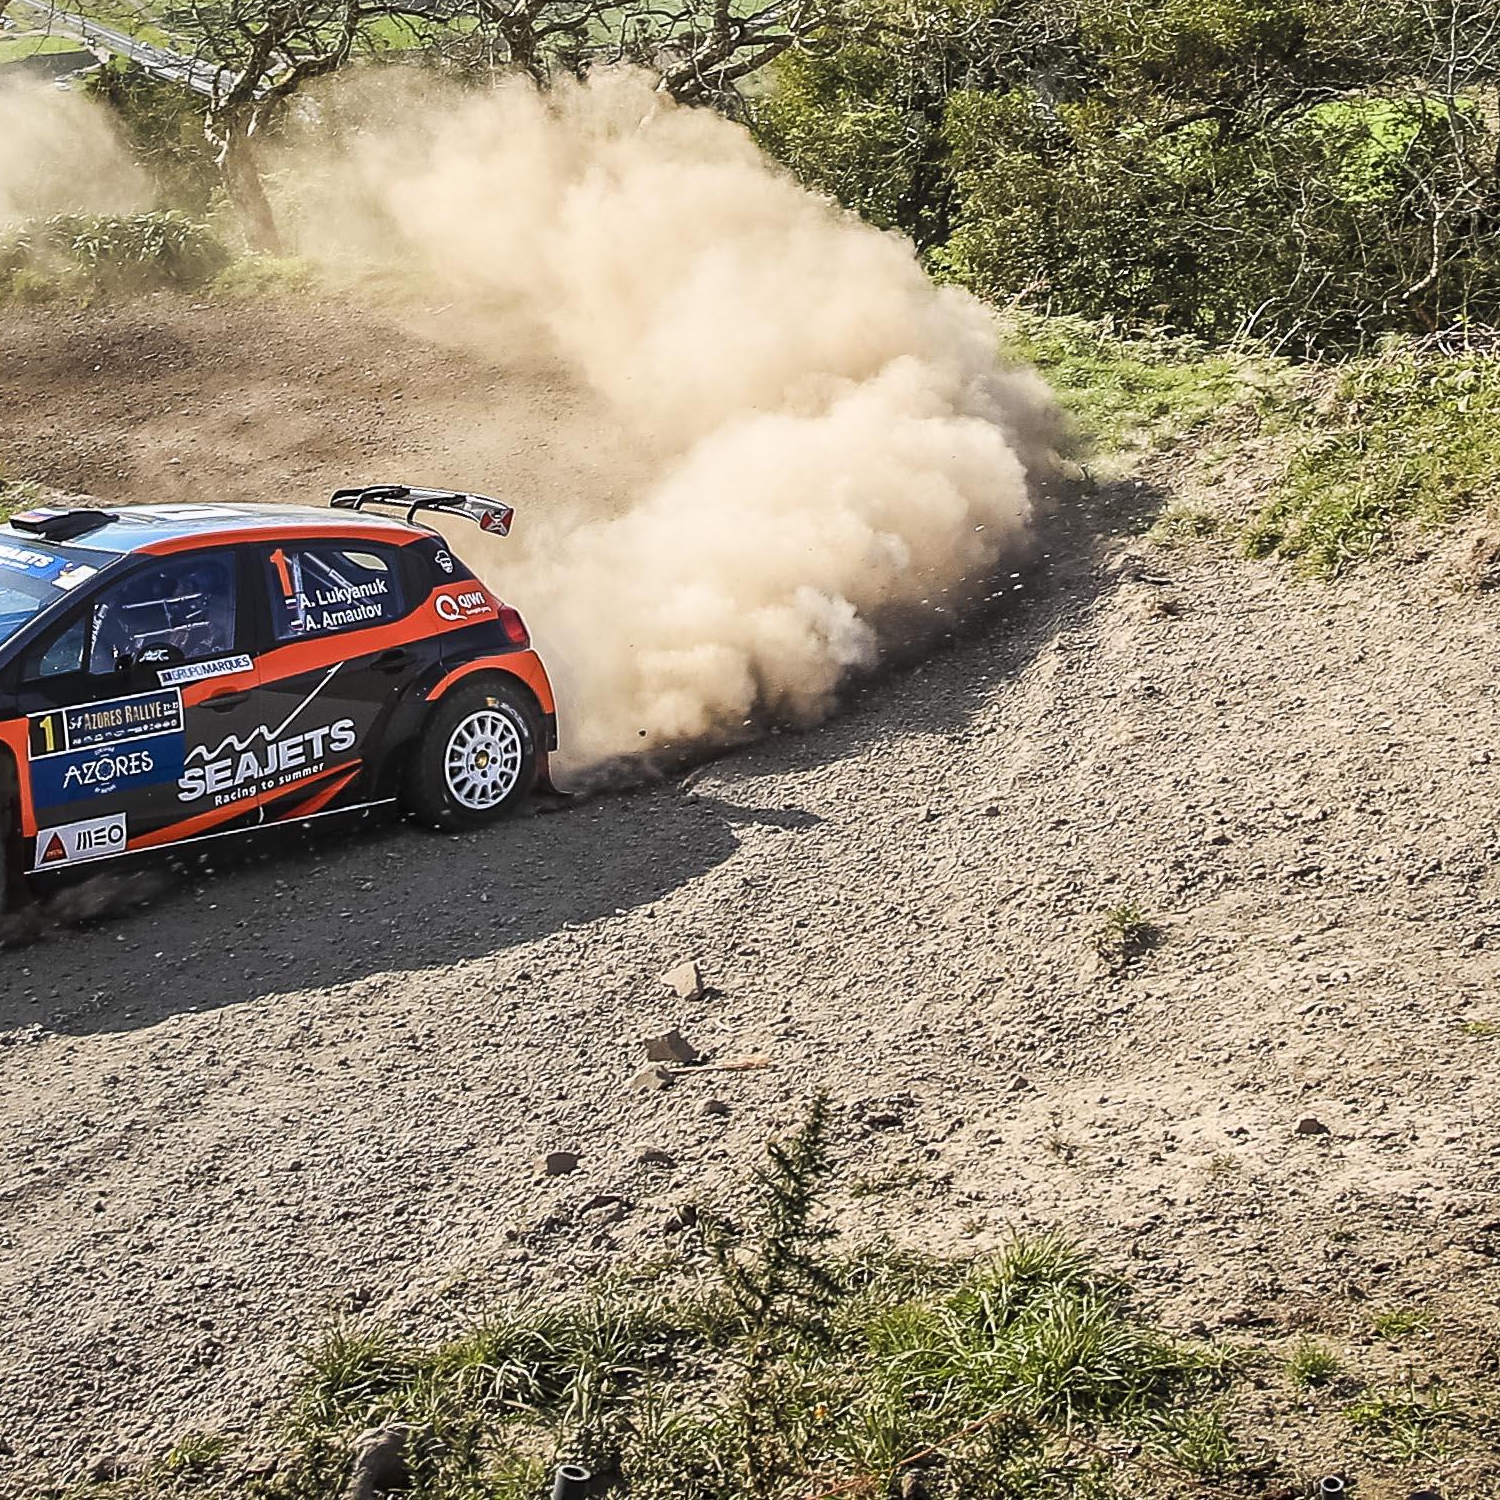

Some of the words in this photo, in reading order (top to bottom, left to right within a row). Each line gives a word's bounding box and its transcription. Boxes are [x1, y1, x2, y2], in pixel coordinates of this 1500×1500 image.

[269, 548, 293, 597] 1
[299, 593, 316, 609] A.
[316, 578, 389, 605] Lukyanuk
[305, 614, 321, 631] A.
[322, 603, 383, 628] Arnautov
[39, 715, 56, 752] 1
[68, 715, 83, 731] 54
[83, 710, 122, 731] AZORES
[125, 701, 162, 724] RALLYE
[63, 750, 154, 789] AZORES
[177, 718, 357, 802] SEAJETS
[214, 785, 257, 807] Racing
[261, 779, 275, 791] to
[278, 762, 325, 785] summer
[75, 824, 124, 851] MEO
